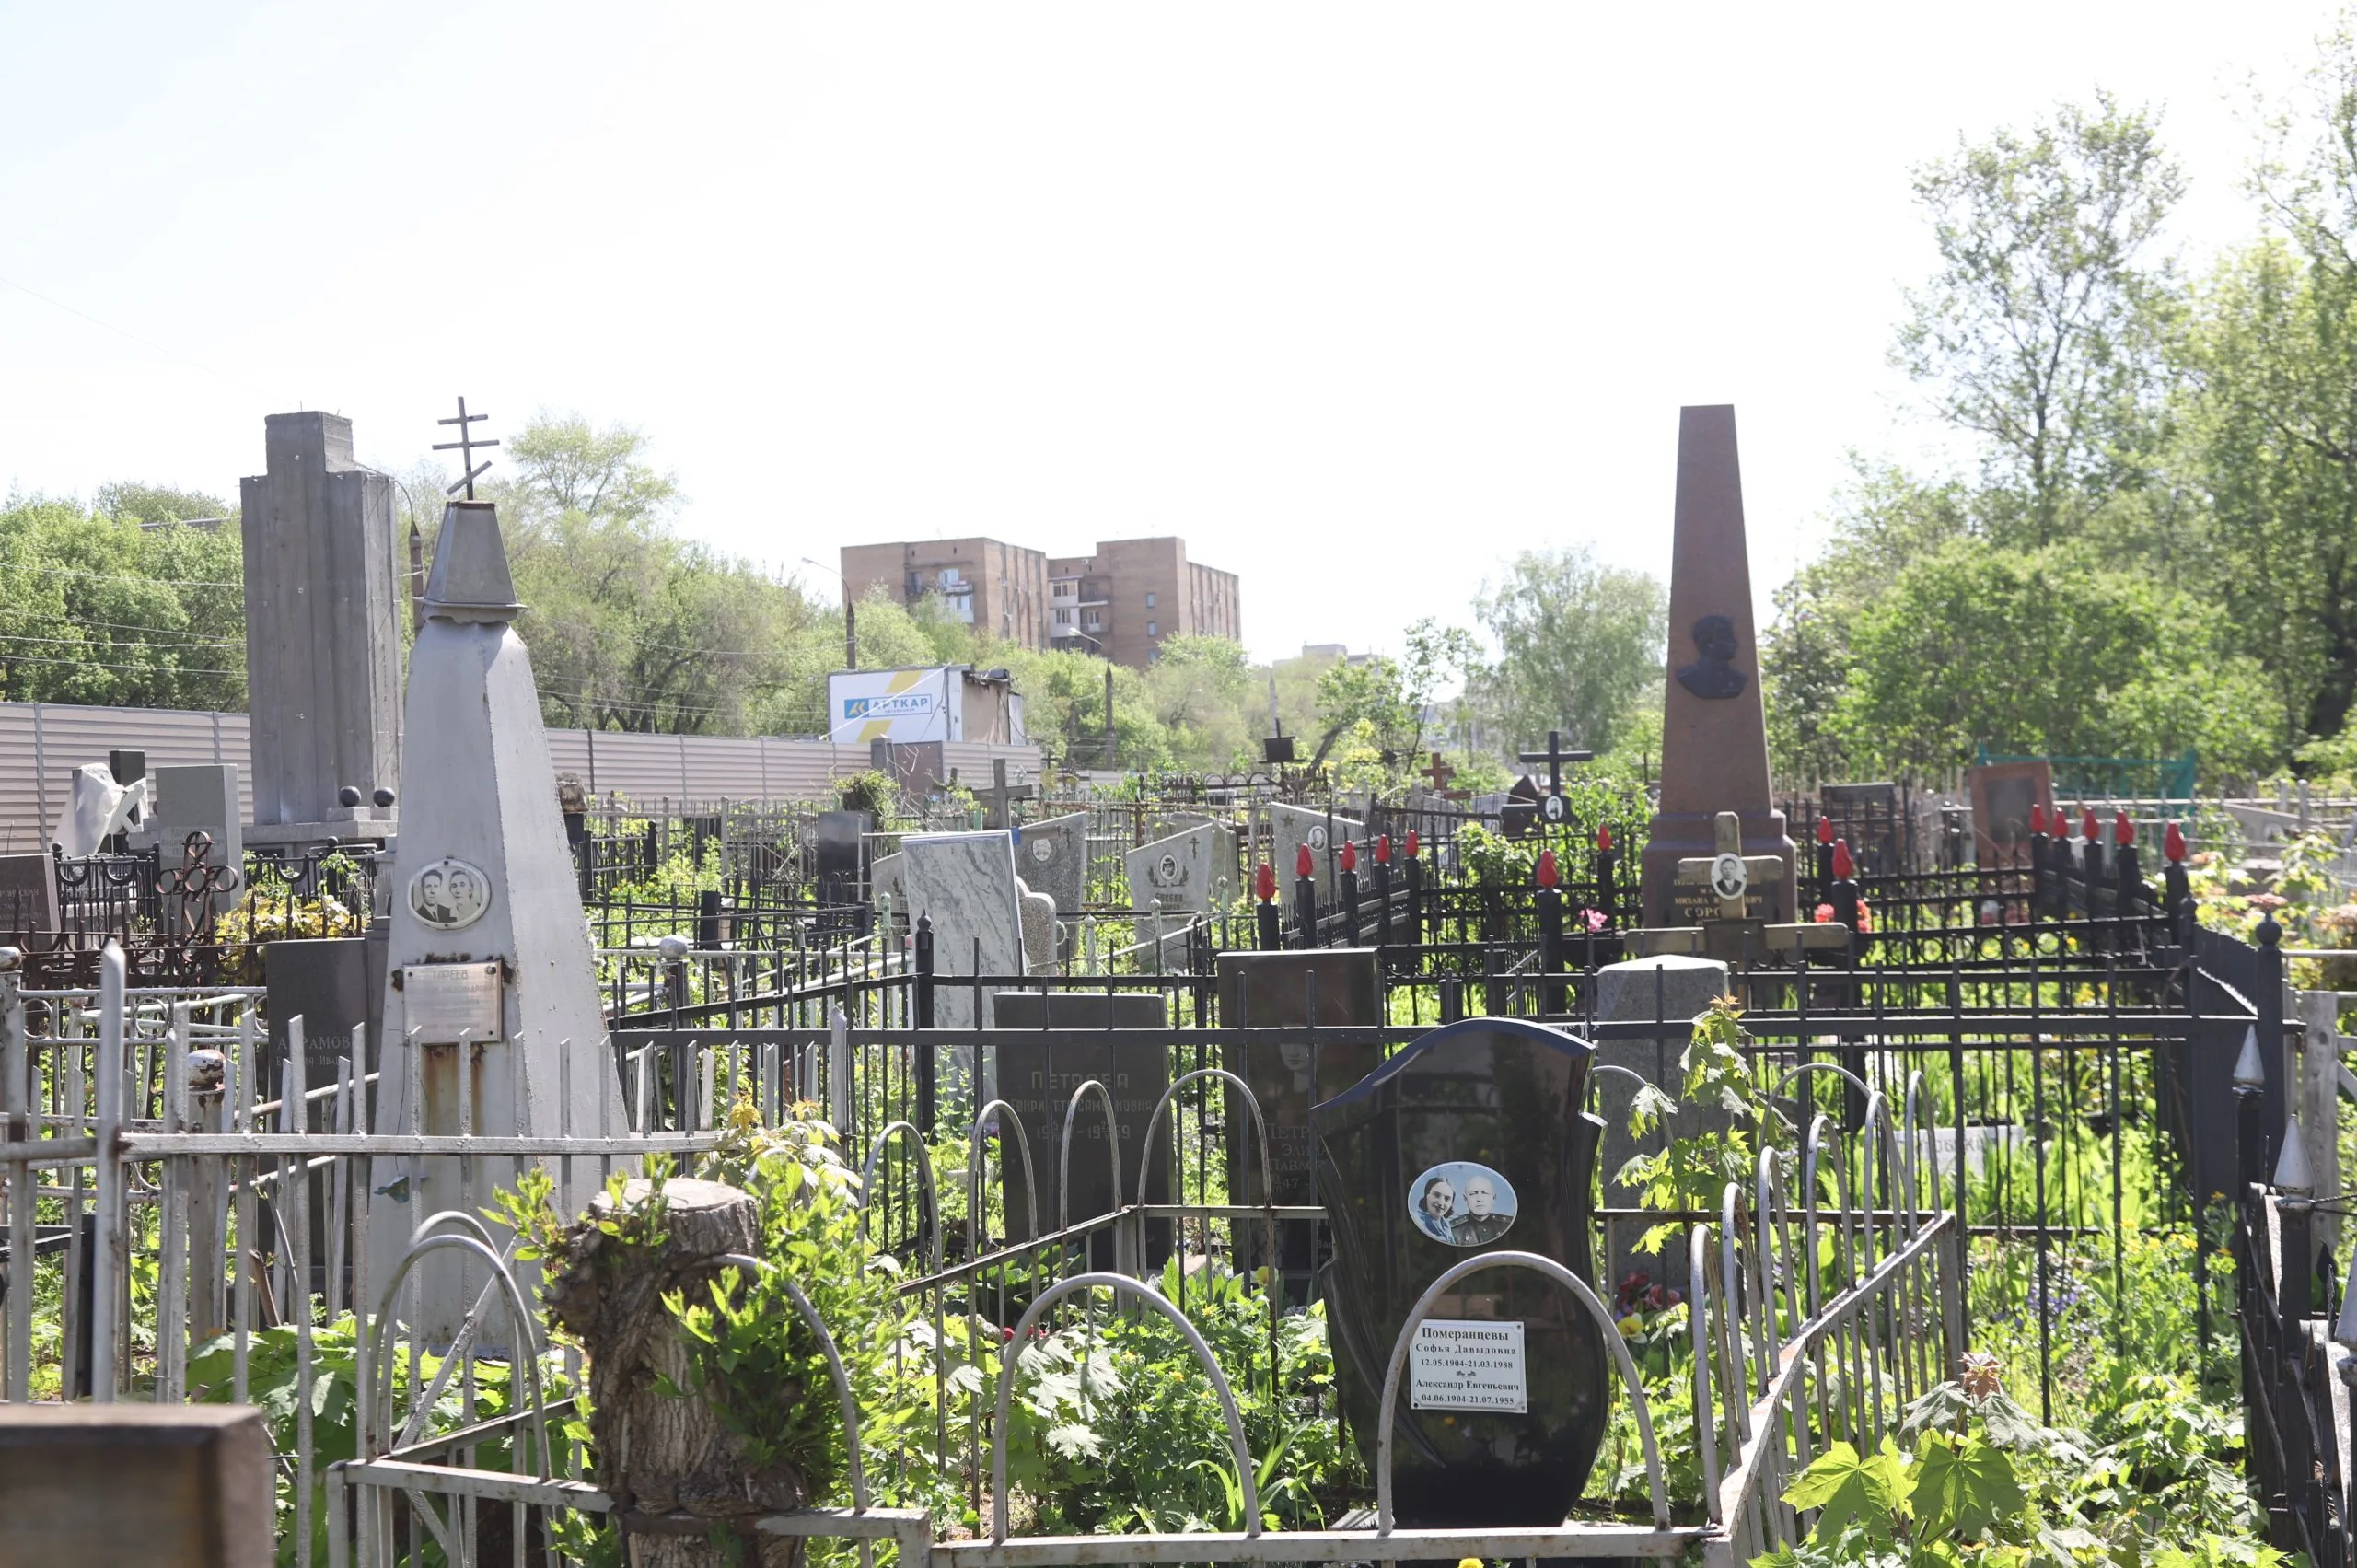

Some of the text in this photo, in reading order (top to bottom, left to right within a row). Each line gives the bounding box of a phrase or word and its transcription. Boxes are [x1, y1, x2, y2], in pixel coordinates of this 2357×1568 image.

[277, 1036, 351, 1050] АРАМОВ
[1422, 1327, 1509, 1342] Померанцевы
[1415, 1343, 1517, 1355] Софья Давыдовна
[1421, 1358, 1513, 1369] 12.05.1904-21.03.1988
[1415, 1379, 1519, 1392] Александр Евгеньевич
[1422, 1394, 1515, 1405] 04.06.1904-21.07.1955
